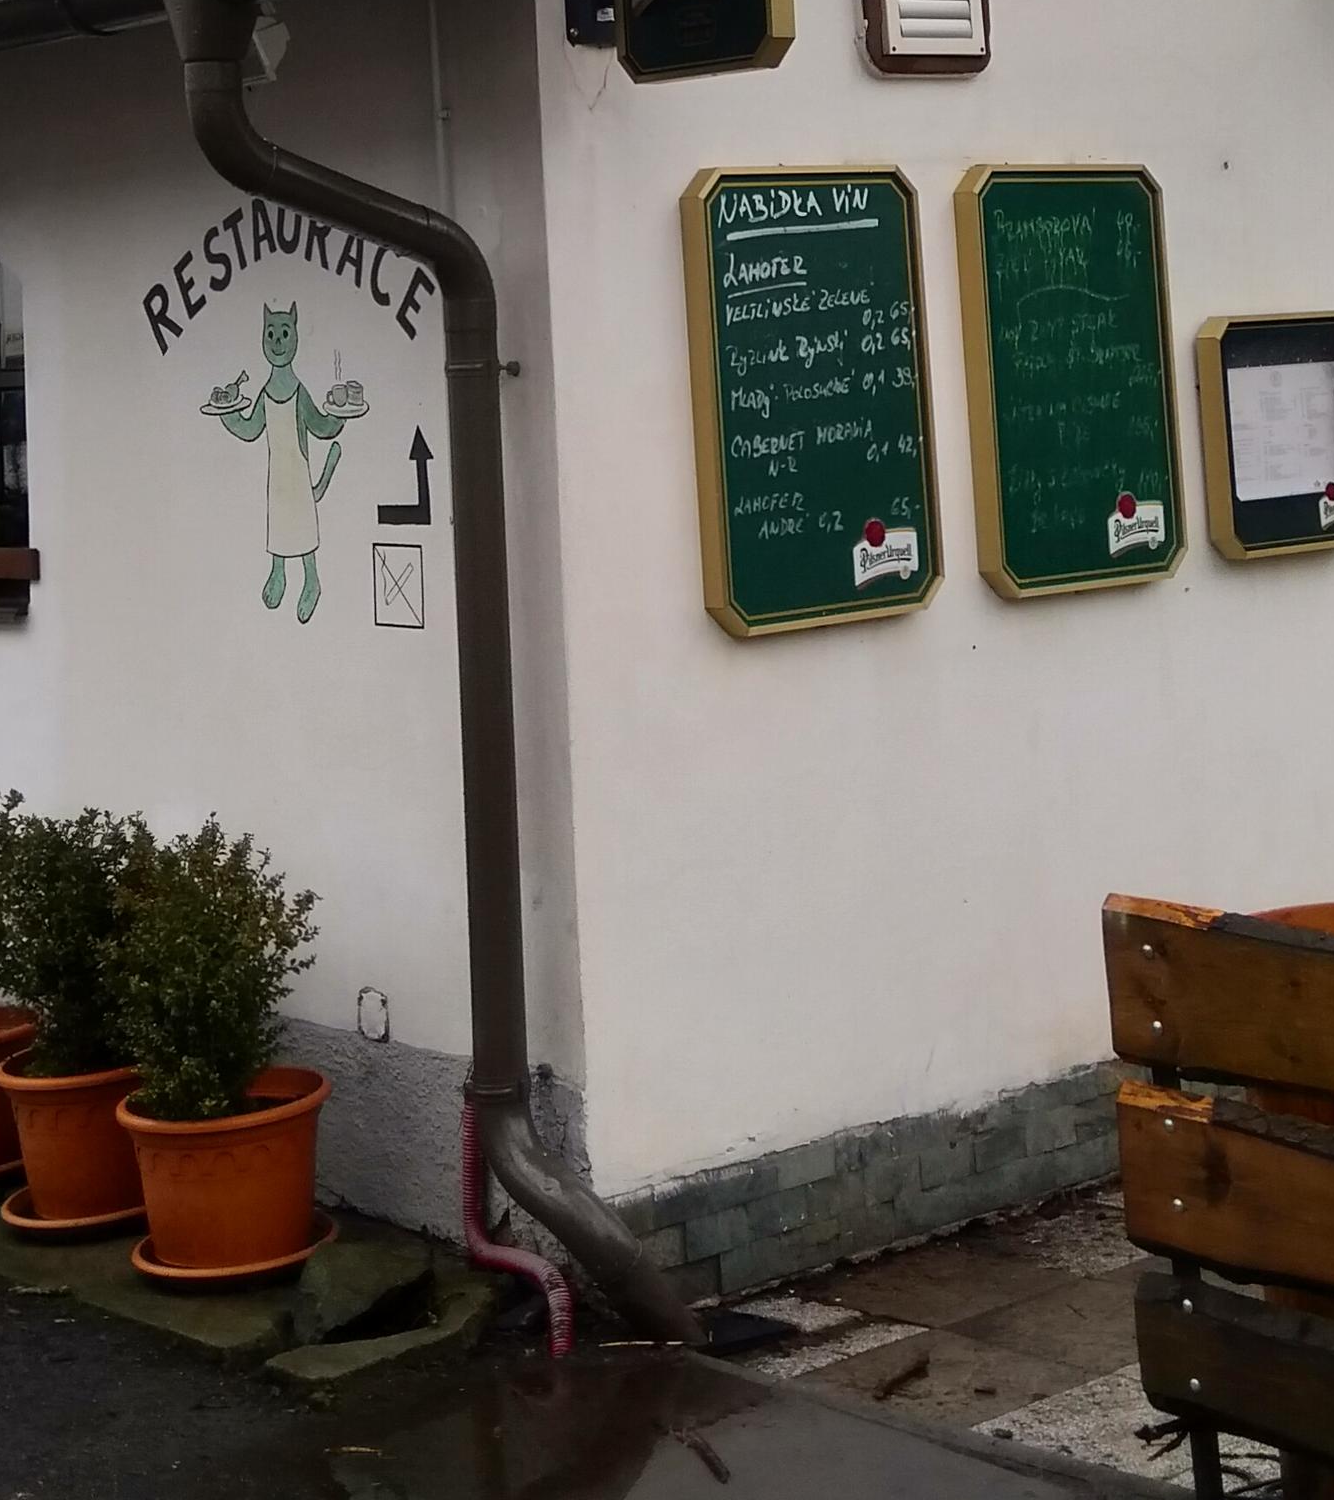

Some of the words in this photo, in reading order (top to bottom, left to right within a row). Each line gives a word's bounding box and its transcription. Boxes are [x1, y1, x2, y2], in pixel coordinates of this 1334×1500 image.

[143, 198, 436, 356] RESTAURACE
[731, 430, 805, 458] CABERNET
[859, 547, 888, 574] Pilsner
[885, 544, 912, 563] Urquell
